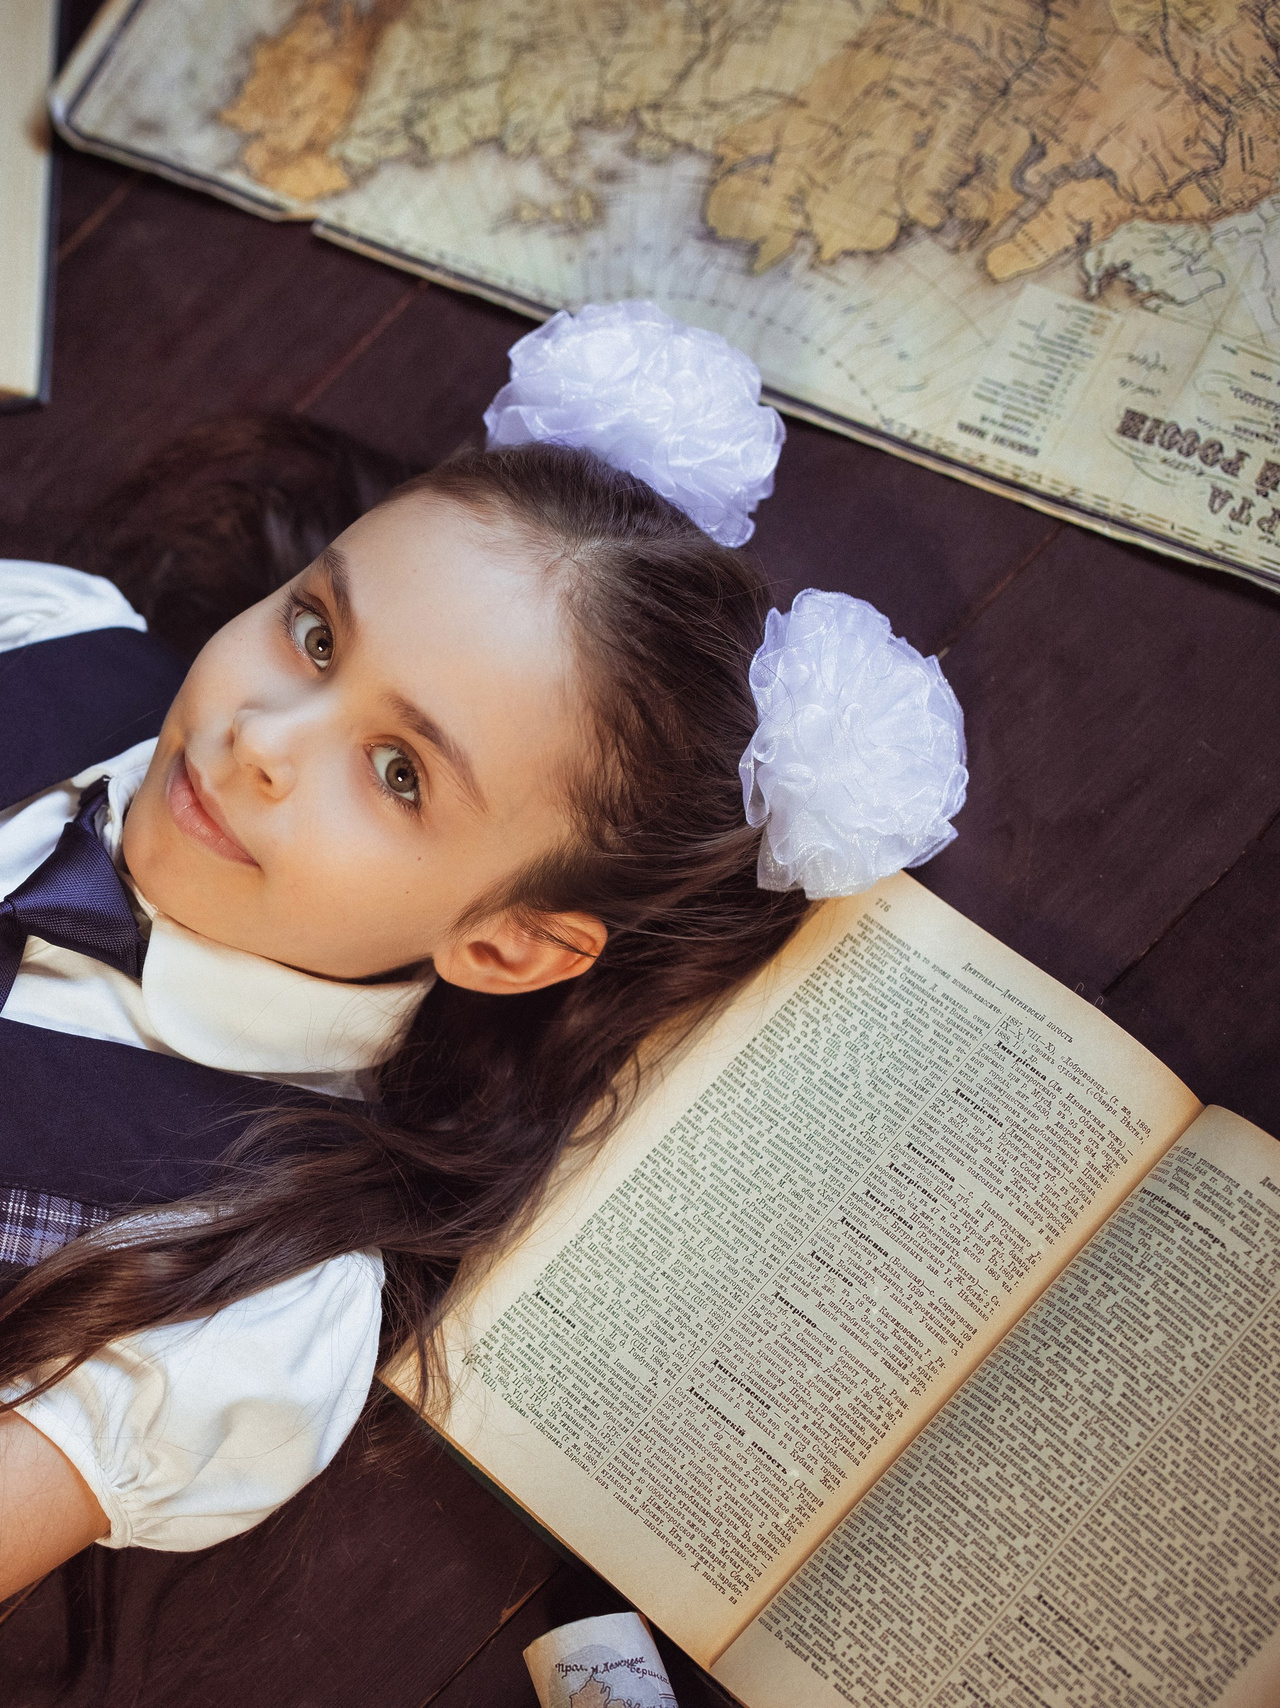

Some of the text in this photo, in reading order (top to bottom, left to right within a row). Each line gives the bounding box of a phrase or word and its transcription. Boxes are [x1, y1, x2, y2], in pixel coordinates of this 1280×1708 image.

[875, 898, 892, 913] 776
[994, 1039, 1047, 1081] Дмитріевка
[861, 1188, 913, 1230] Дмитріевка
[837, 1215, 889, 1257] Дмитріевка
[532, 1290, 576, 1329] Дмитріева
[710, 1358, 771, 1410] Дмитріевская
[686, 1385, 746, 1437] Дмитріевскій
